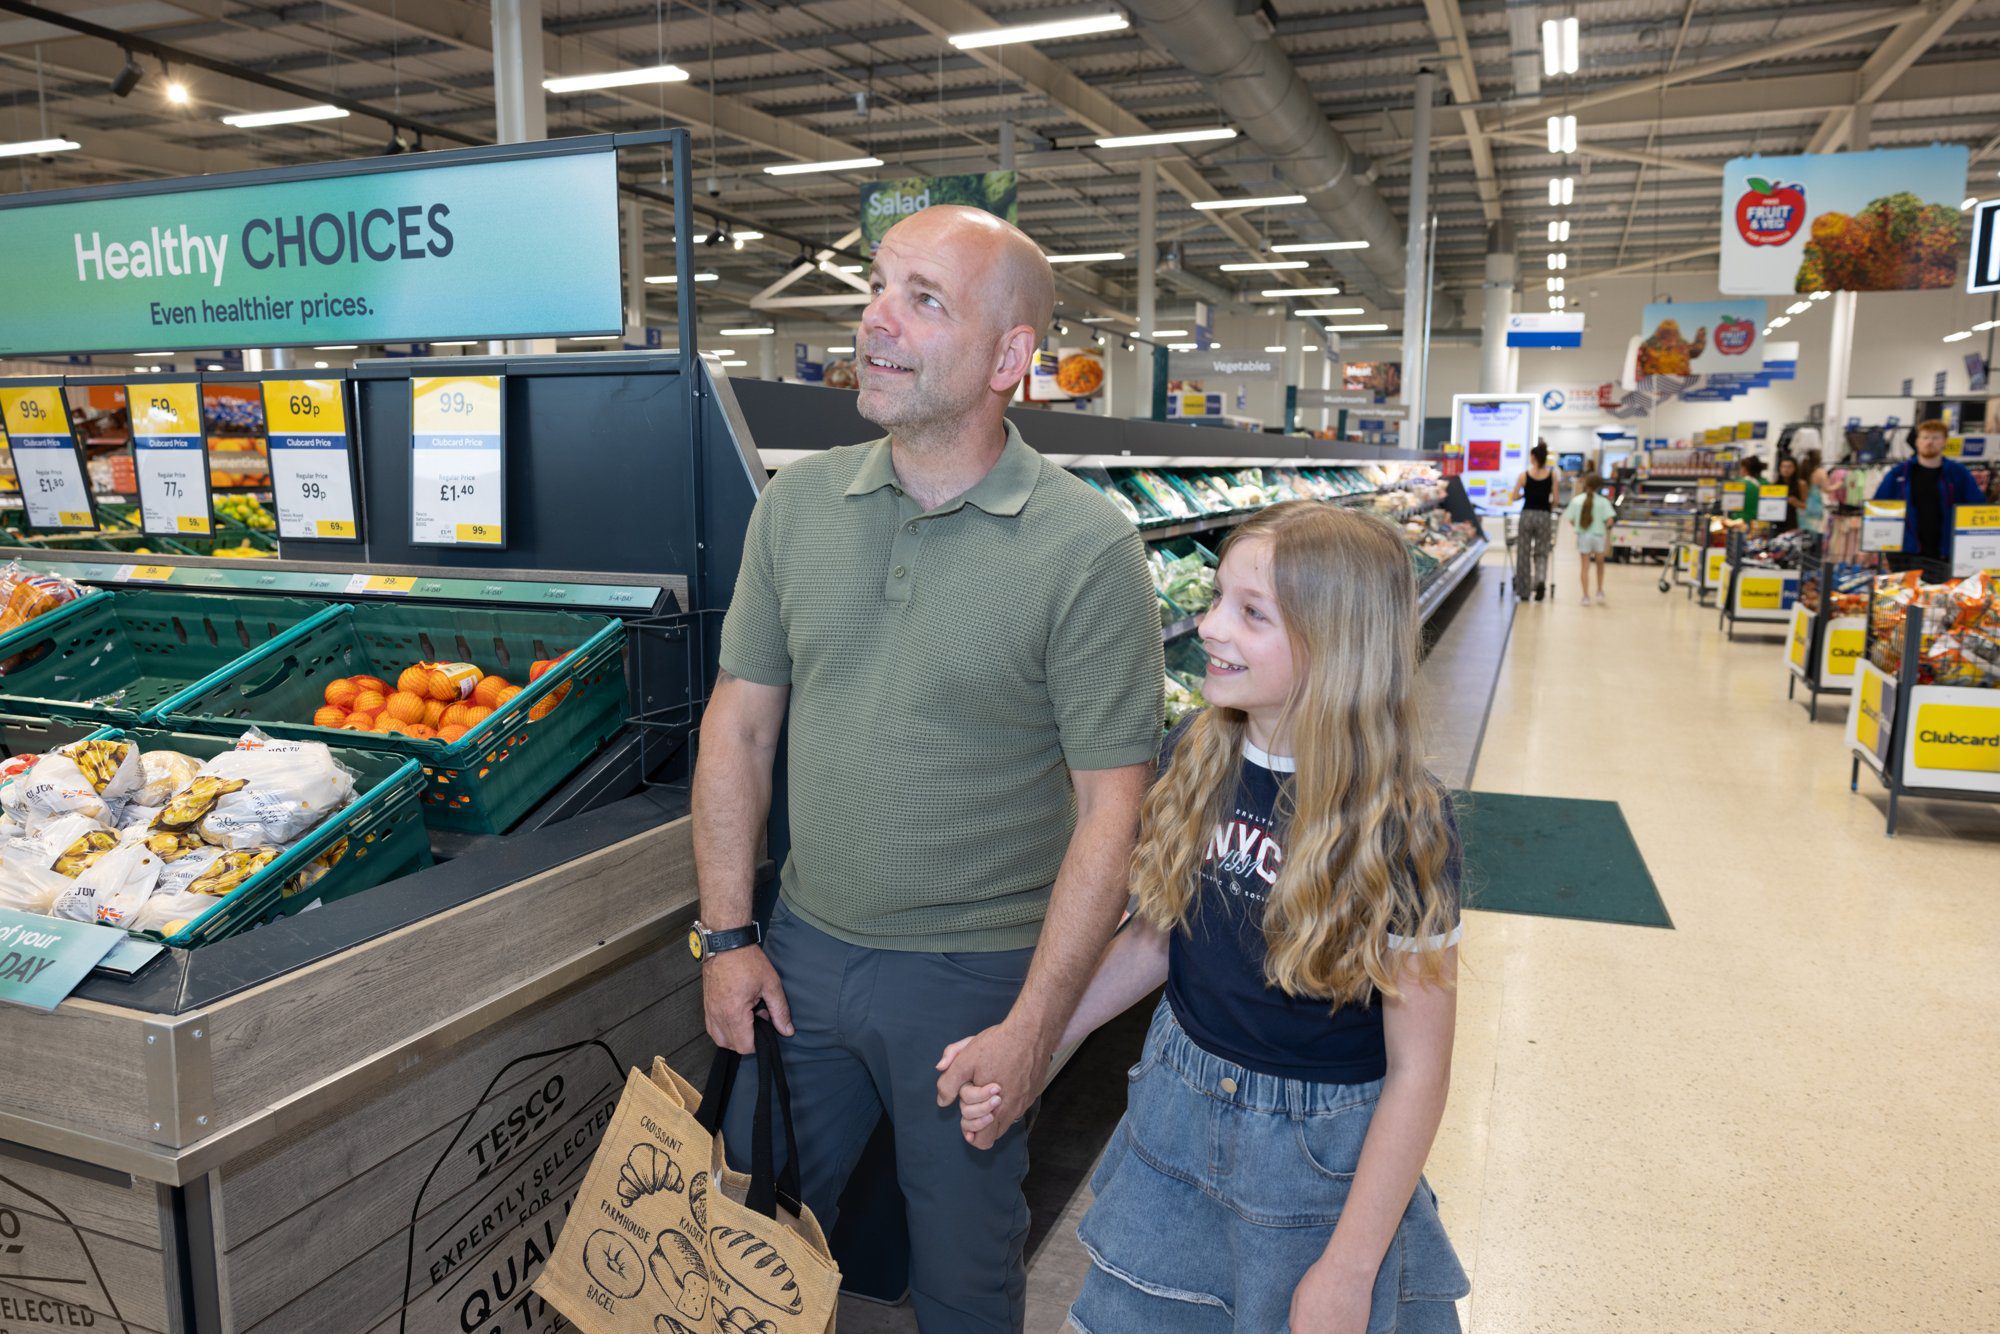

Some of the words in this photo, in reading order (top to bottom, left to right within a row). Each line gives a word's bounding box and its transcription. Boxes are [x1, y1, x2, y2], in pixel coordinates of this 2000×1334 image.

[869, 189, 930, 216] Salad
[1746, 205, 1793, 220] FRUIT
[73, 224, 229, 287] Healthy
[241, 203, 454, 269] CHOICES
[150, 300, 196, 326] Even
[202, 294, 294, 323] healthier
[300, 294, 374, 325] prices.
[1213, 361, 1271, 374] Vegetables
[20, 400, 46, 420] 99p
[290, 395, 320, 418] 69p
[440, 392, 473, 416] 99p
[23, 438, 47, 447] Clubcard
[47, 438, 61, 447] Price
[149, 439, 174, 448] Clubcard
[174, 439, 188, 448] Price
[287, 438, 314, 447] Clubcard
[315, 438, 332, 447] Price
[432, 438, 464, 447] Clubcard
[465, 438, 483, 447] Price
[164, 481, 183, 499] 77p
[302, 482, 326, 501] 99p
[440, 484, 474, 501] £1.40
[330, 522, 343, 531] 69p
[472, 526, 487, 536] 99p
[1920, 730, 2000, 748] Clubcard
[1205, 821, 1282, 885] NYC
[0, 924, 24, 942] of
[9, 929, 62, 950] your
[0, 951, 57, 984] DAY
[467, 1074, 565, 1167] TESCO
[640, 1115, 683, 1155] CROISSANT
[430, 1183, 526, 1286] EXPERTLY
[533, 1101, 617, 1188] SELECTED
[518, 1188, 552, 1229] FOR
[600, 1199, 652, 1245] FARMHOUSE
[679, 1216, 705, 1246] KAISER
[710, 1264, 731, 1297] OMER
[587, 1284, 615, 1315] BAGEL
[0, 1297, 95, 1328] ELECTED
